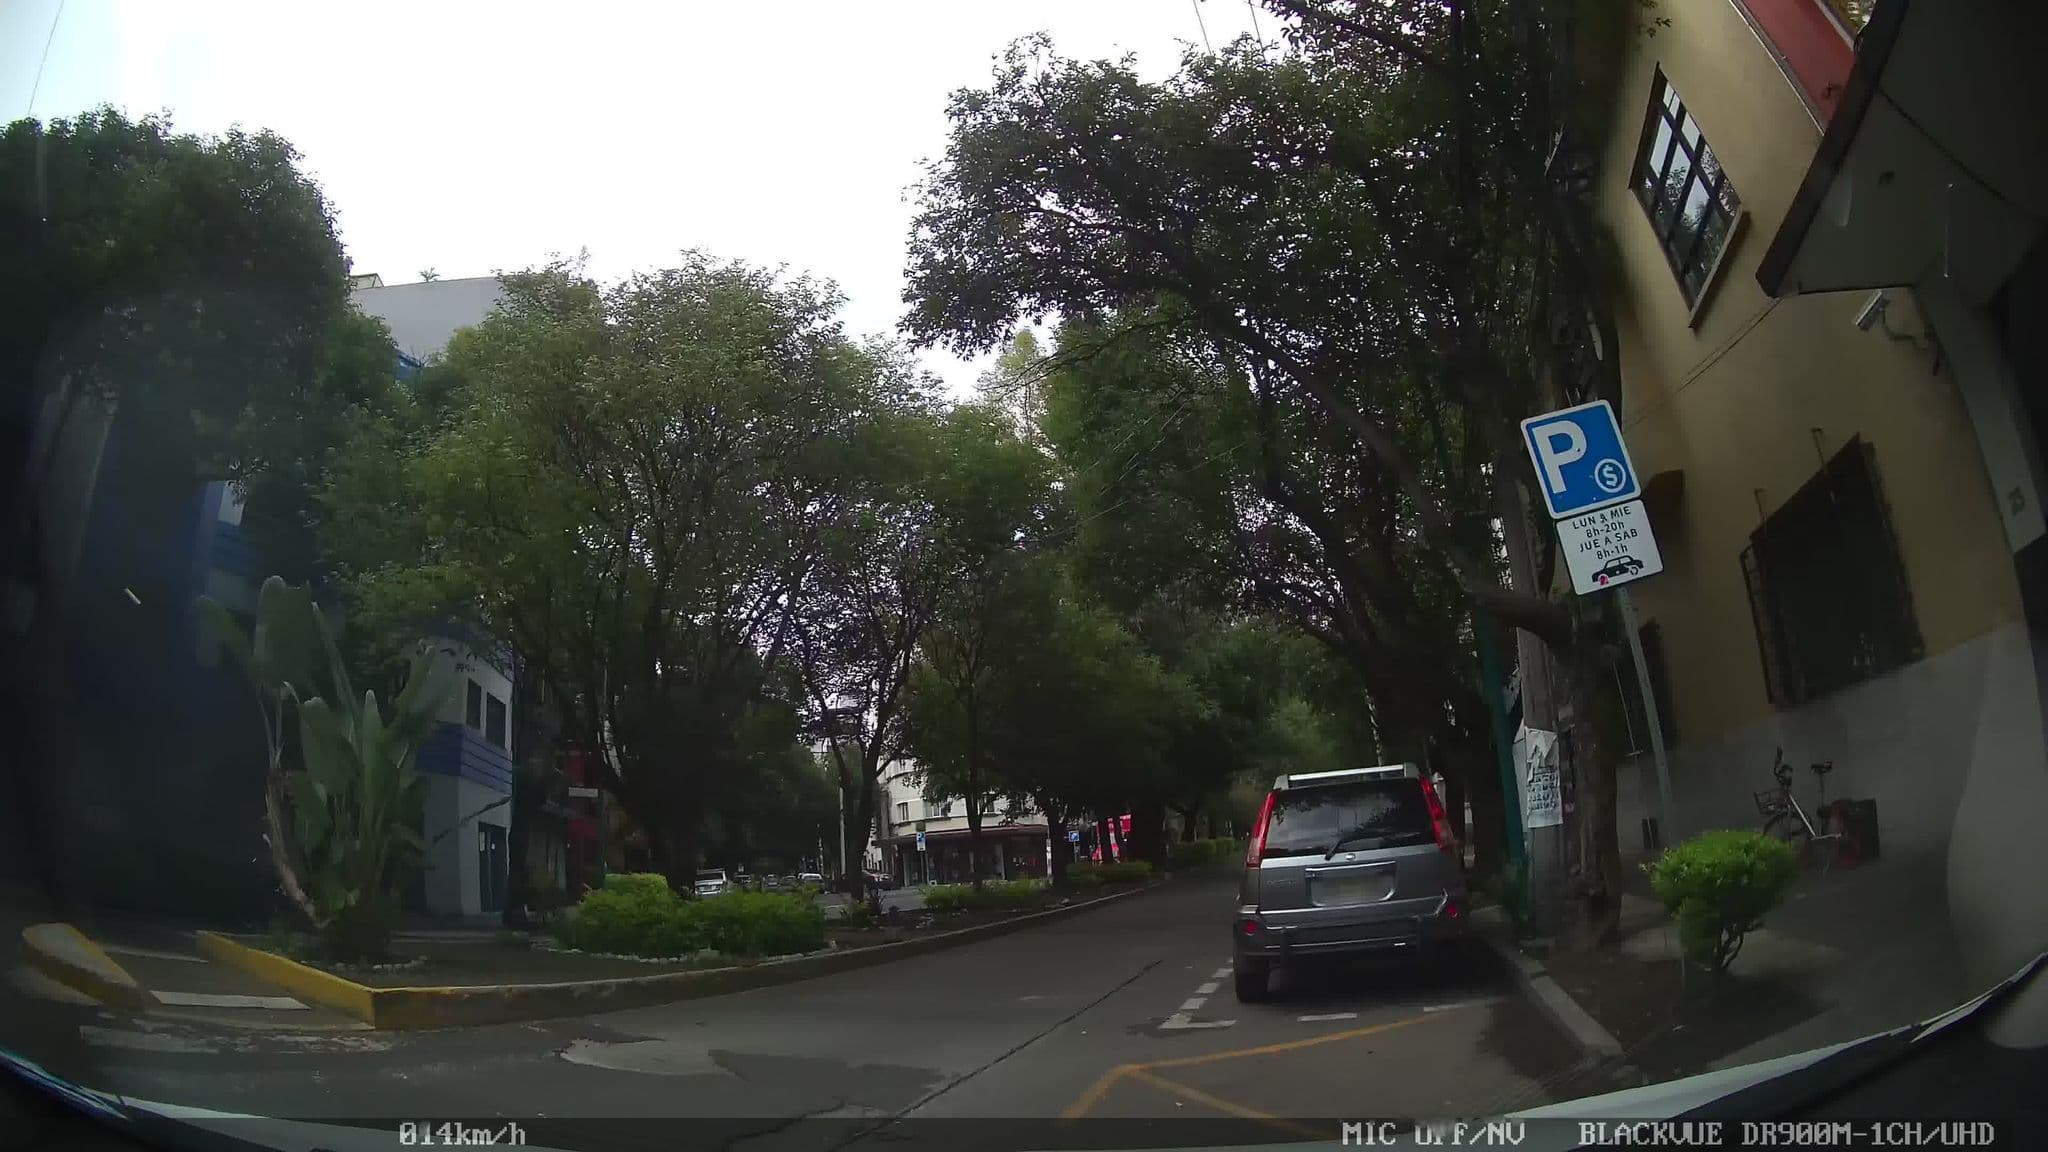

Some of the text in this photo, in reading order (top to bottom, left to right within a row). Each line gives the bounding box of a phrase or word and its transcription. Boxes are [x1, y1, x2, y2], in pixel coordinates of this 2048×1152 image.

[1532, 420, 1587, 494] P
[1602, 464, 1618, 486] $
[1572, 506, 1631, 529] LUN A MIE
[1580, 529, 1638, 552] JUE A SAB
[1586, 521, 1625, 538] 8h-20h
[1596, 544, 1628, 559] 8h-1h
